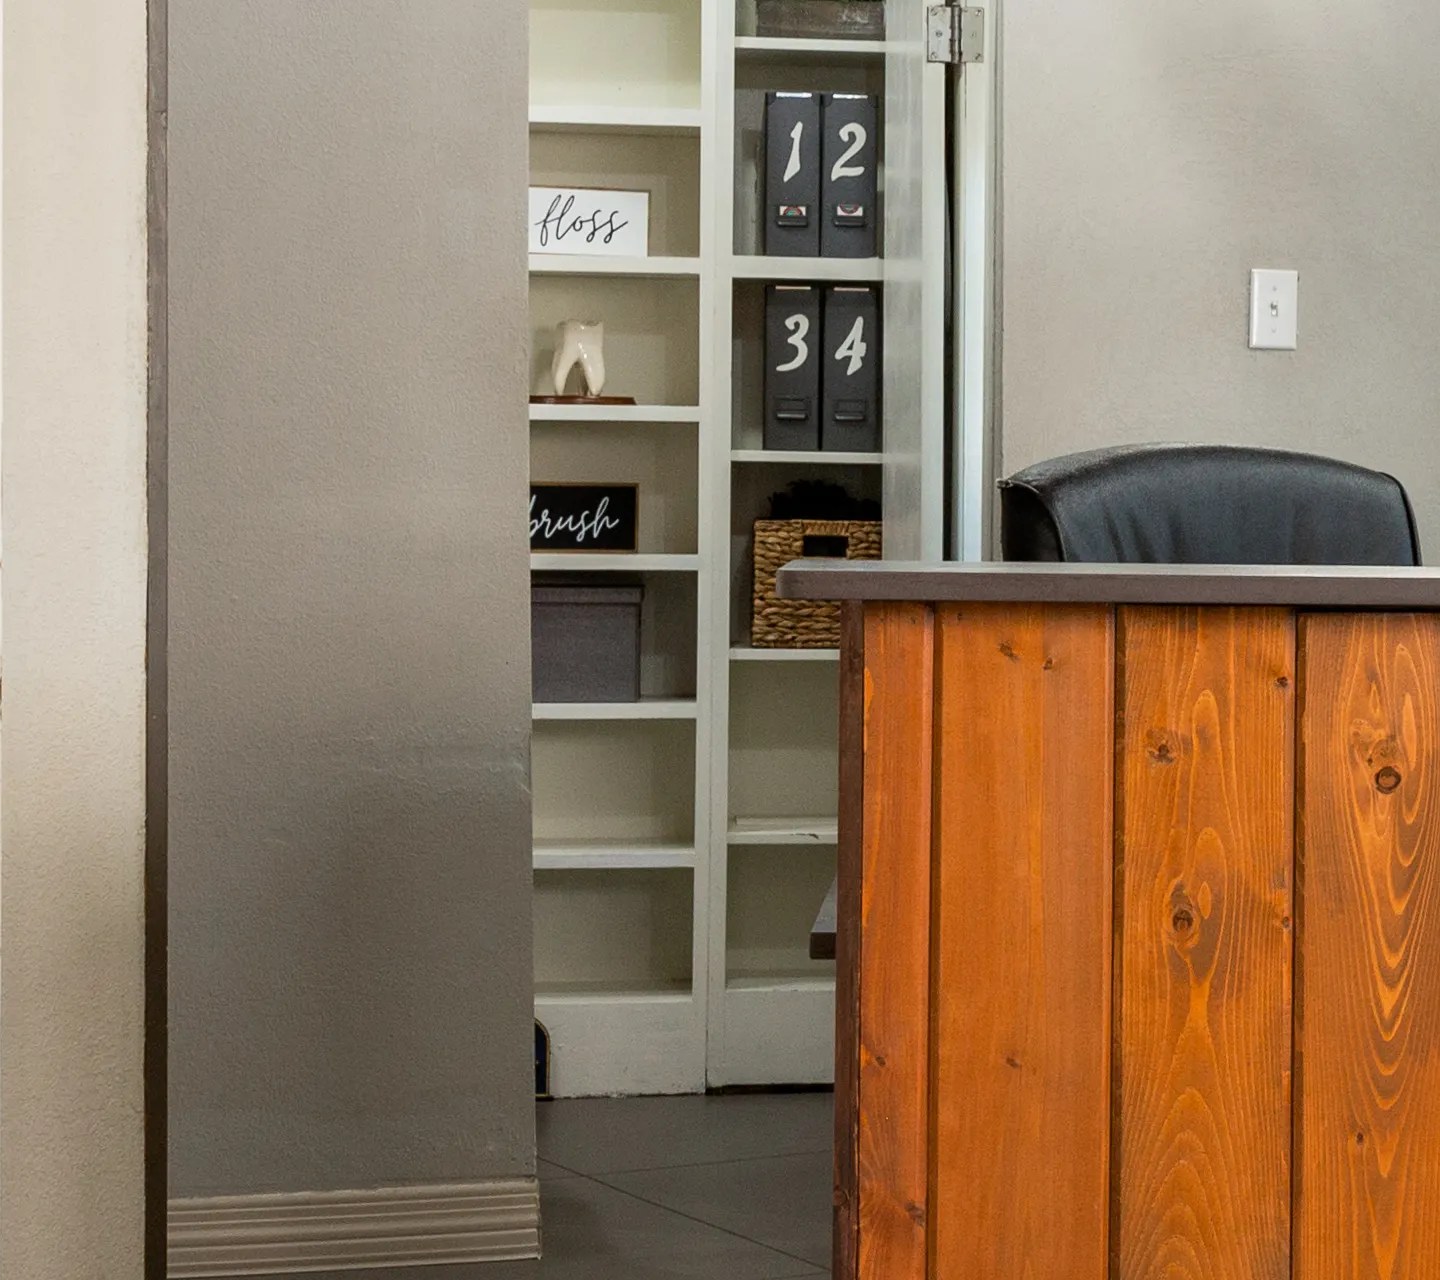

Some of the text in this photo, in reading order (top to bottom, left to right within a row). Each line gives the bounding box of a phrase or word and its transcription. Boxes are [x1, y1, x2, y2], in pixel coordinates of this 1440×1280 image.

[783, 121, 803, 182] 1
[831, 122, 867, 181] 2
[533, 194, 628, 247] floss
[776, 313, 809, 372] 3
[834, 316, 866, 376] 4
